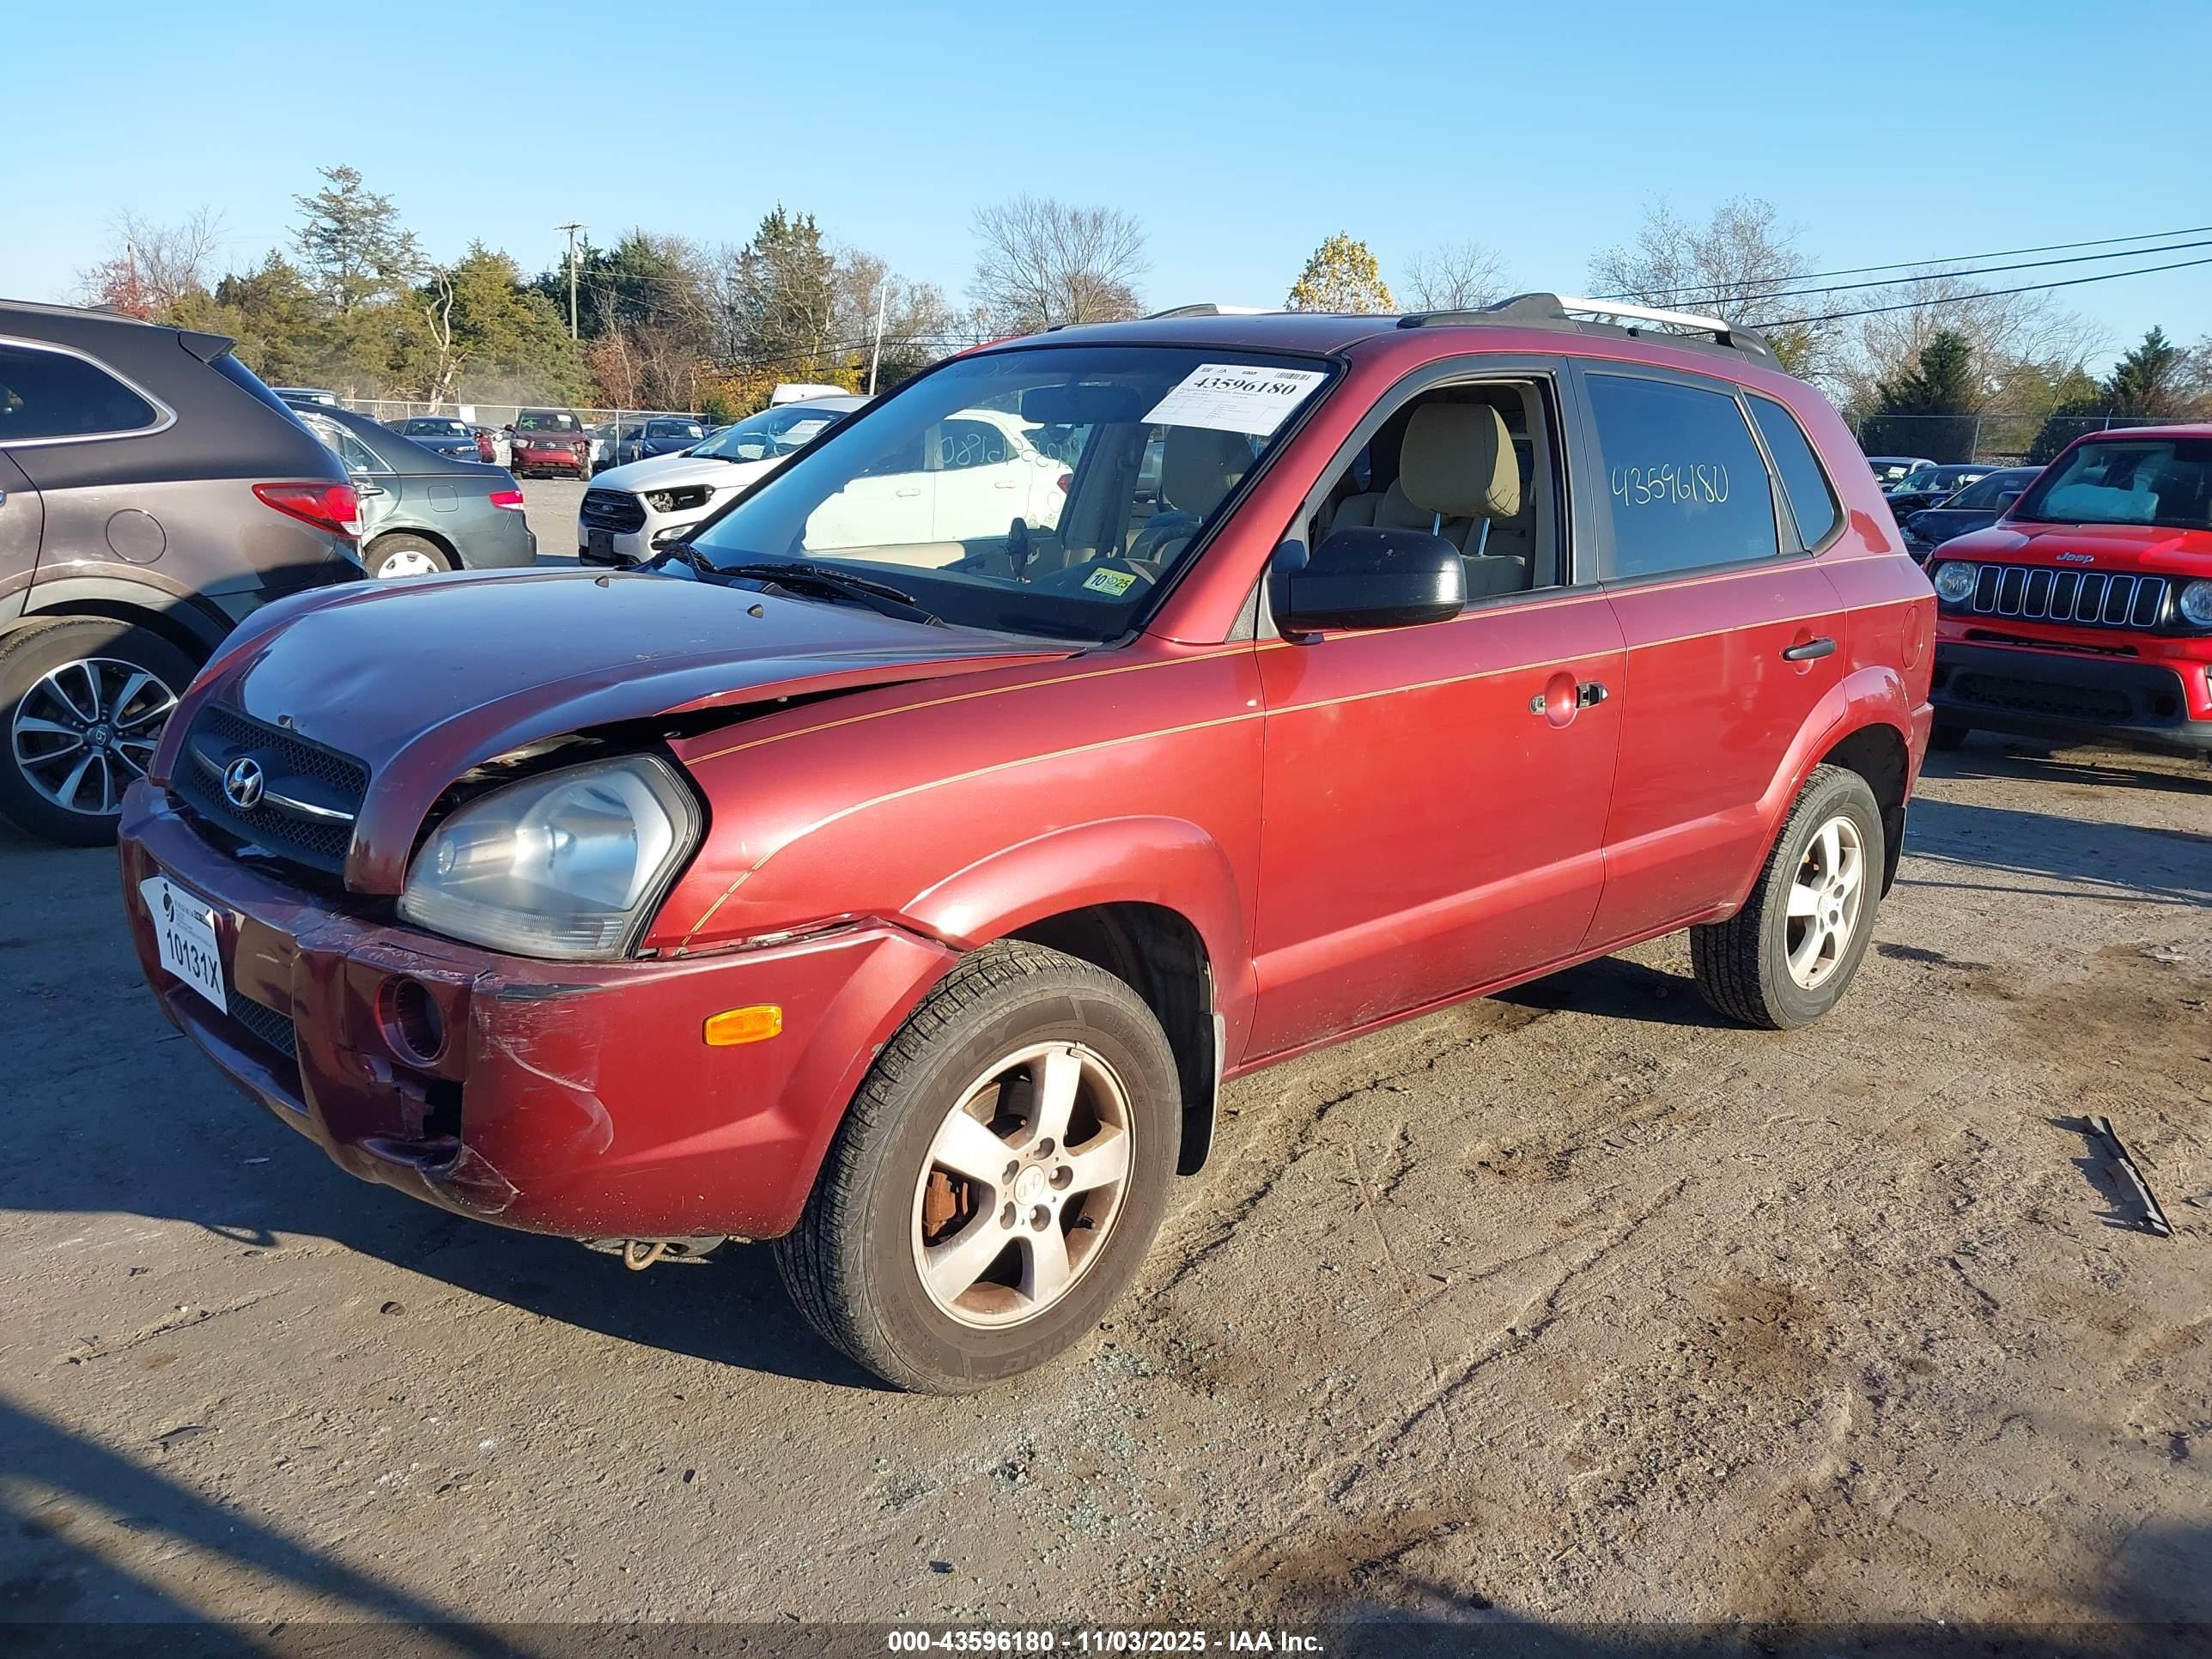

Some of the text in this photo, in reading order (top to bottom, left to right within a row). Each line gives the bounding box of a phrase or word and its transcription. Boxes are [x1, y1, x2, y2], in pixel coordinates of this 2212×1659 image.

[1194, 376, 1297, 397] 43596180
[1611, 460, 1729, 507] 43596180
[2056, 551, 2095, 564] Jeep
[1091, 573, 1108, 586] 10
[1114, 578, 1131, 589] 25
[165, 927, 221, 994] 10131X
